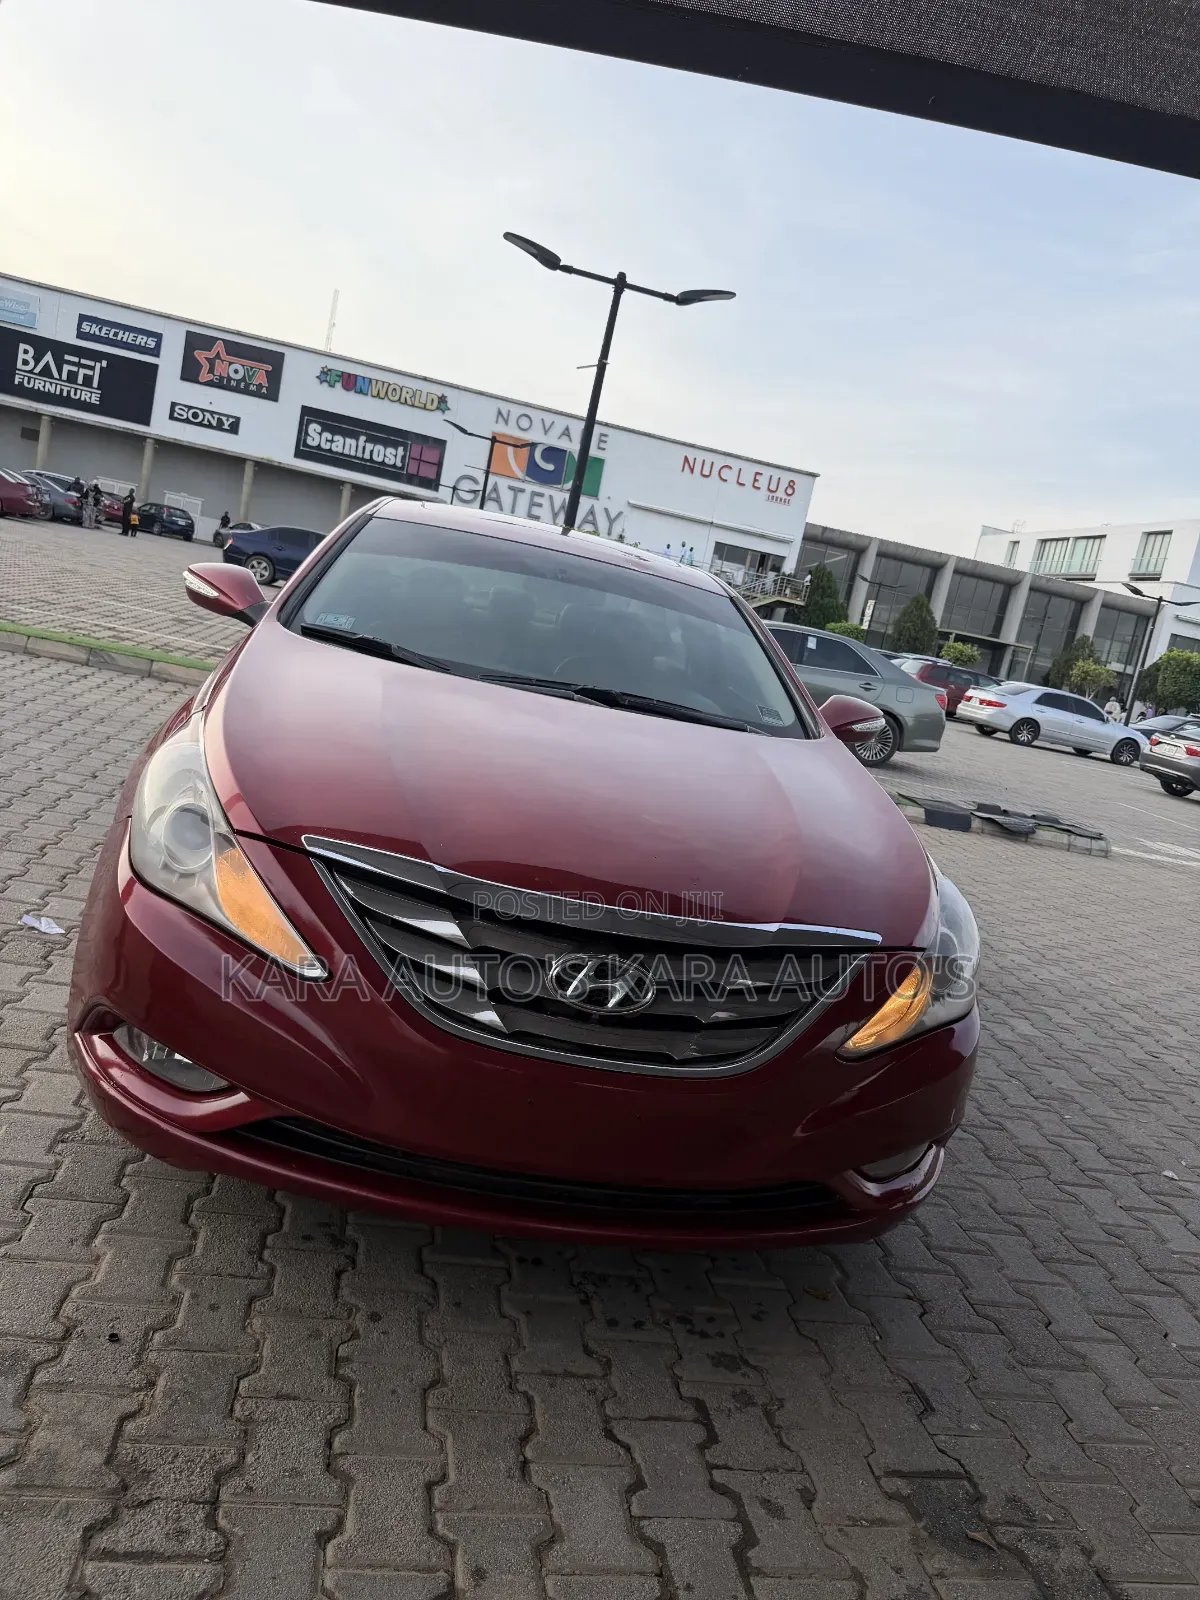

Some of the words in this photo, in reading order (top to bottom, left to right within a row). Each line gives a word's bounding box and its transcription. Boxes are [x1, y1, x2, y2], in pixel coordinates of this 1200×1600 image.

[80, 321, 158, 349] SKECHERS
[212, 375, 268, 395] CINEMA
[213, 359, 269, 388] NOVA
[14, 374, 101, 405] FURNITURE
[173, 404, 236, 431] SONY
[495, 407, 610, 452] NOVAE
[306, 422, 405, 469] Scanfrost
[453, 474, 624, 537] GATEWAY
